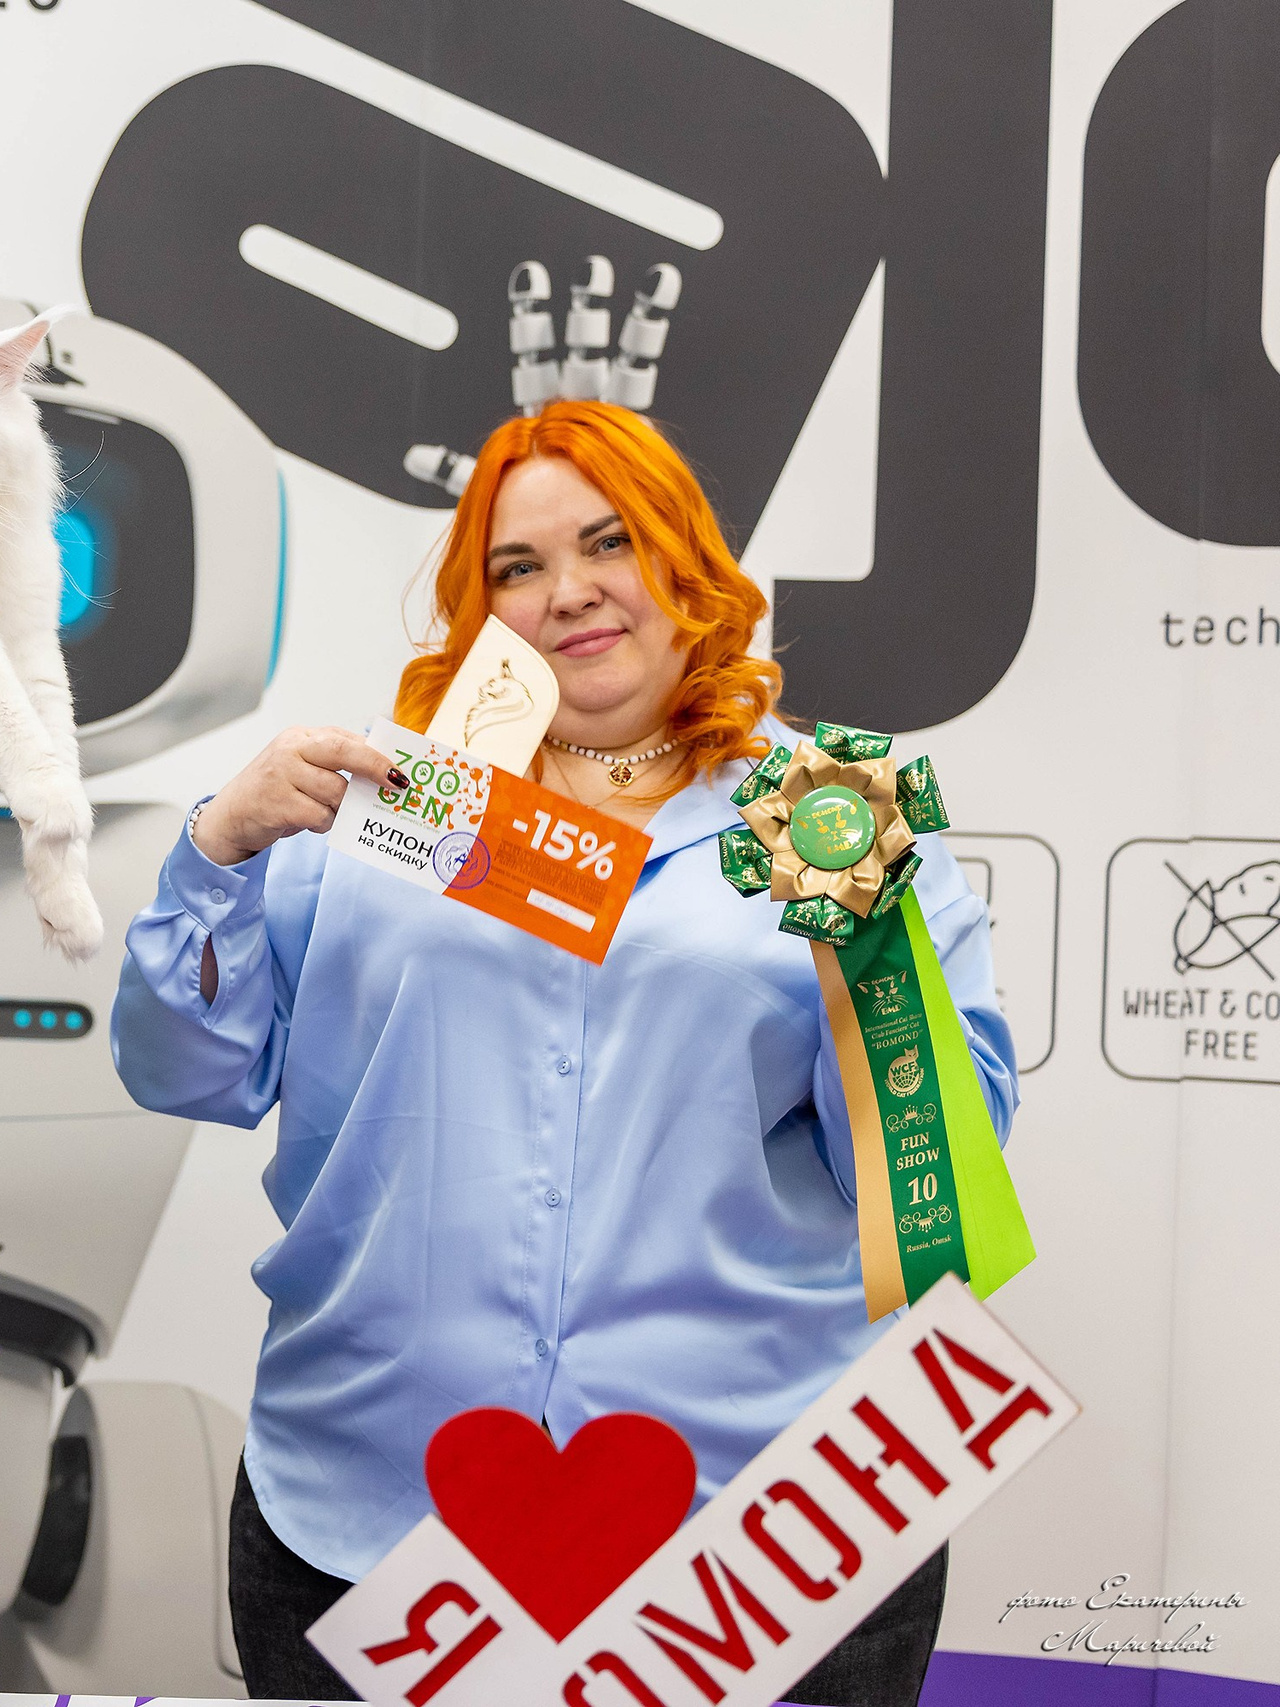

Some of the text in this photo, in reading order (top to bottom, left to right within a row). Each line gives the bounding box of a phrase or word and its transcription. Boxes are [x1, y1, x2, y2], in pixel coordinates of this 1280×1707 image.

[1160, 605, 1280, 648] tech
[377, 785, 449, 826] GEN
[357, 833, 378, 848] на
[376, 838, 429, 871] скидку
[362, 818, 433, 858] КУПОН
[512, 808, 619, 882] -15%
[1122, 987, 1280, 1021] WHEAT & CO
[865, 1018, 898, 1033] International
[871, 1030, 885, 1040] Club
[909, 1020, 920, 1029] Cat
[1184, 1029, 1259, 1062] FREE
[890, 1061, 915, 1077] WCF
[896, 1147, 940, 1171] SHOW
[900, 1131, 930, 1153] FUN
[906, 1172, 938, 1206] 10
[906, 1234, 952, 1253] Russia, Omsk
[360, 1579, 504, 1707] Я
